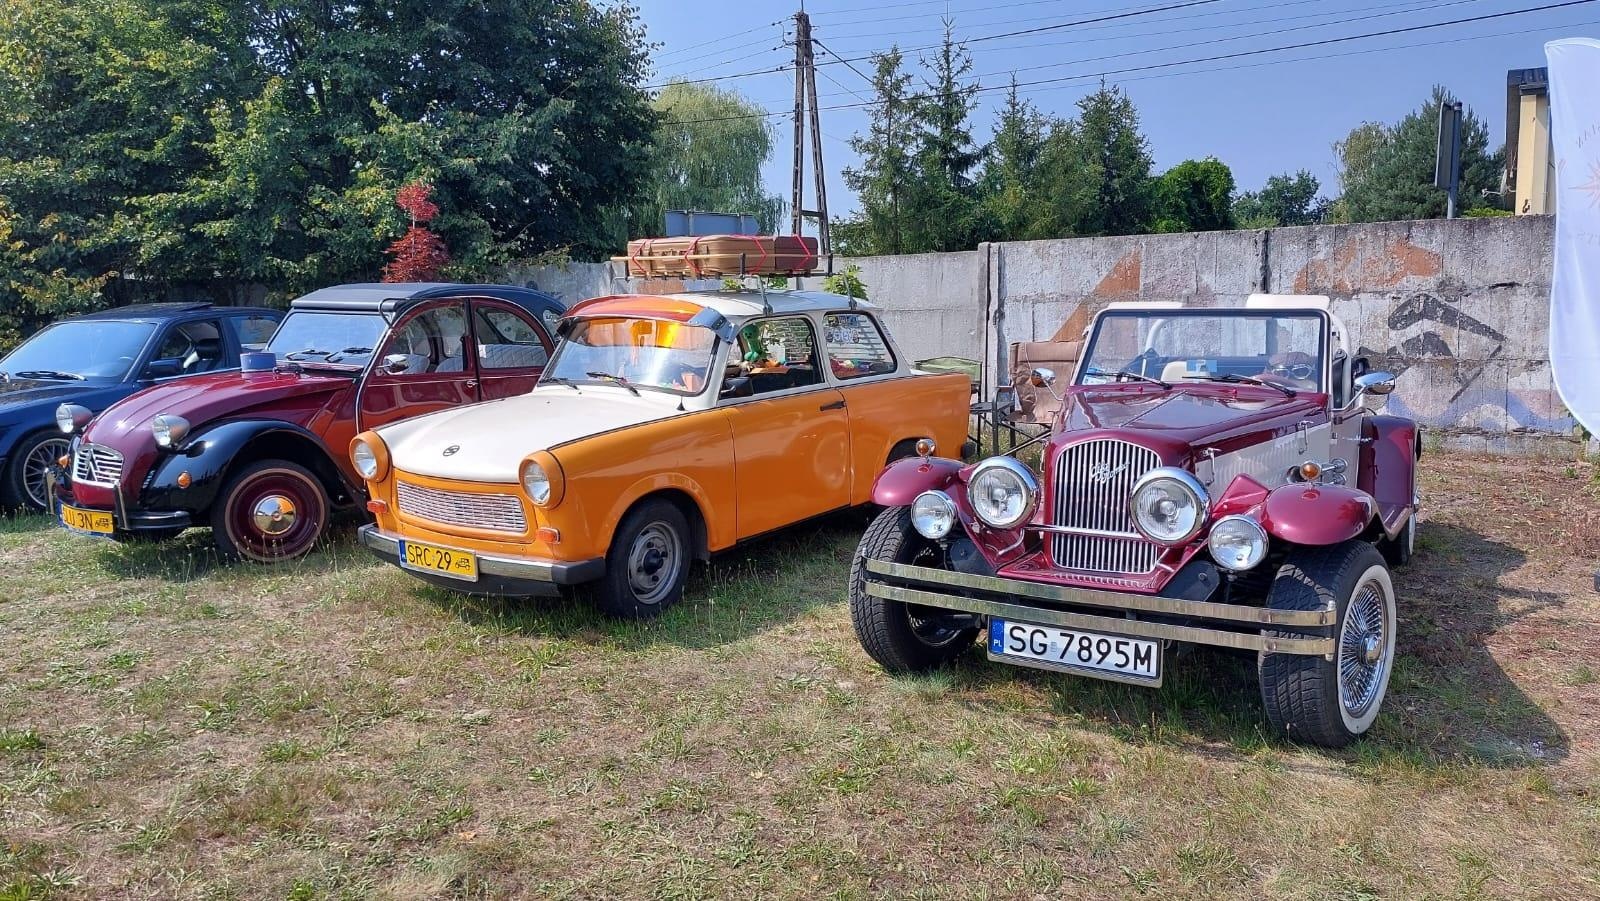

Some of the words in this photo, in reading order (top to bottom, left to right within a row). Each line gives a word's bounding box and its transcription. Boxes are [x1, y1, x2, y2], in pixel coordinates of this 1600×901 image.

[77, 512, 94, 530] 3N
[407, 544, 432, 567] SRC
[436, 550, 452, 571] 29
[993, 640, 1003, 648] PL
[1009, 625, 1048, 656] SG
[1059, 632, 1152, 673] 7895M
